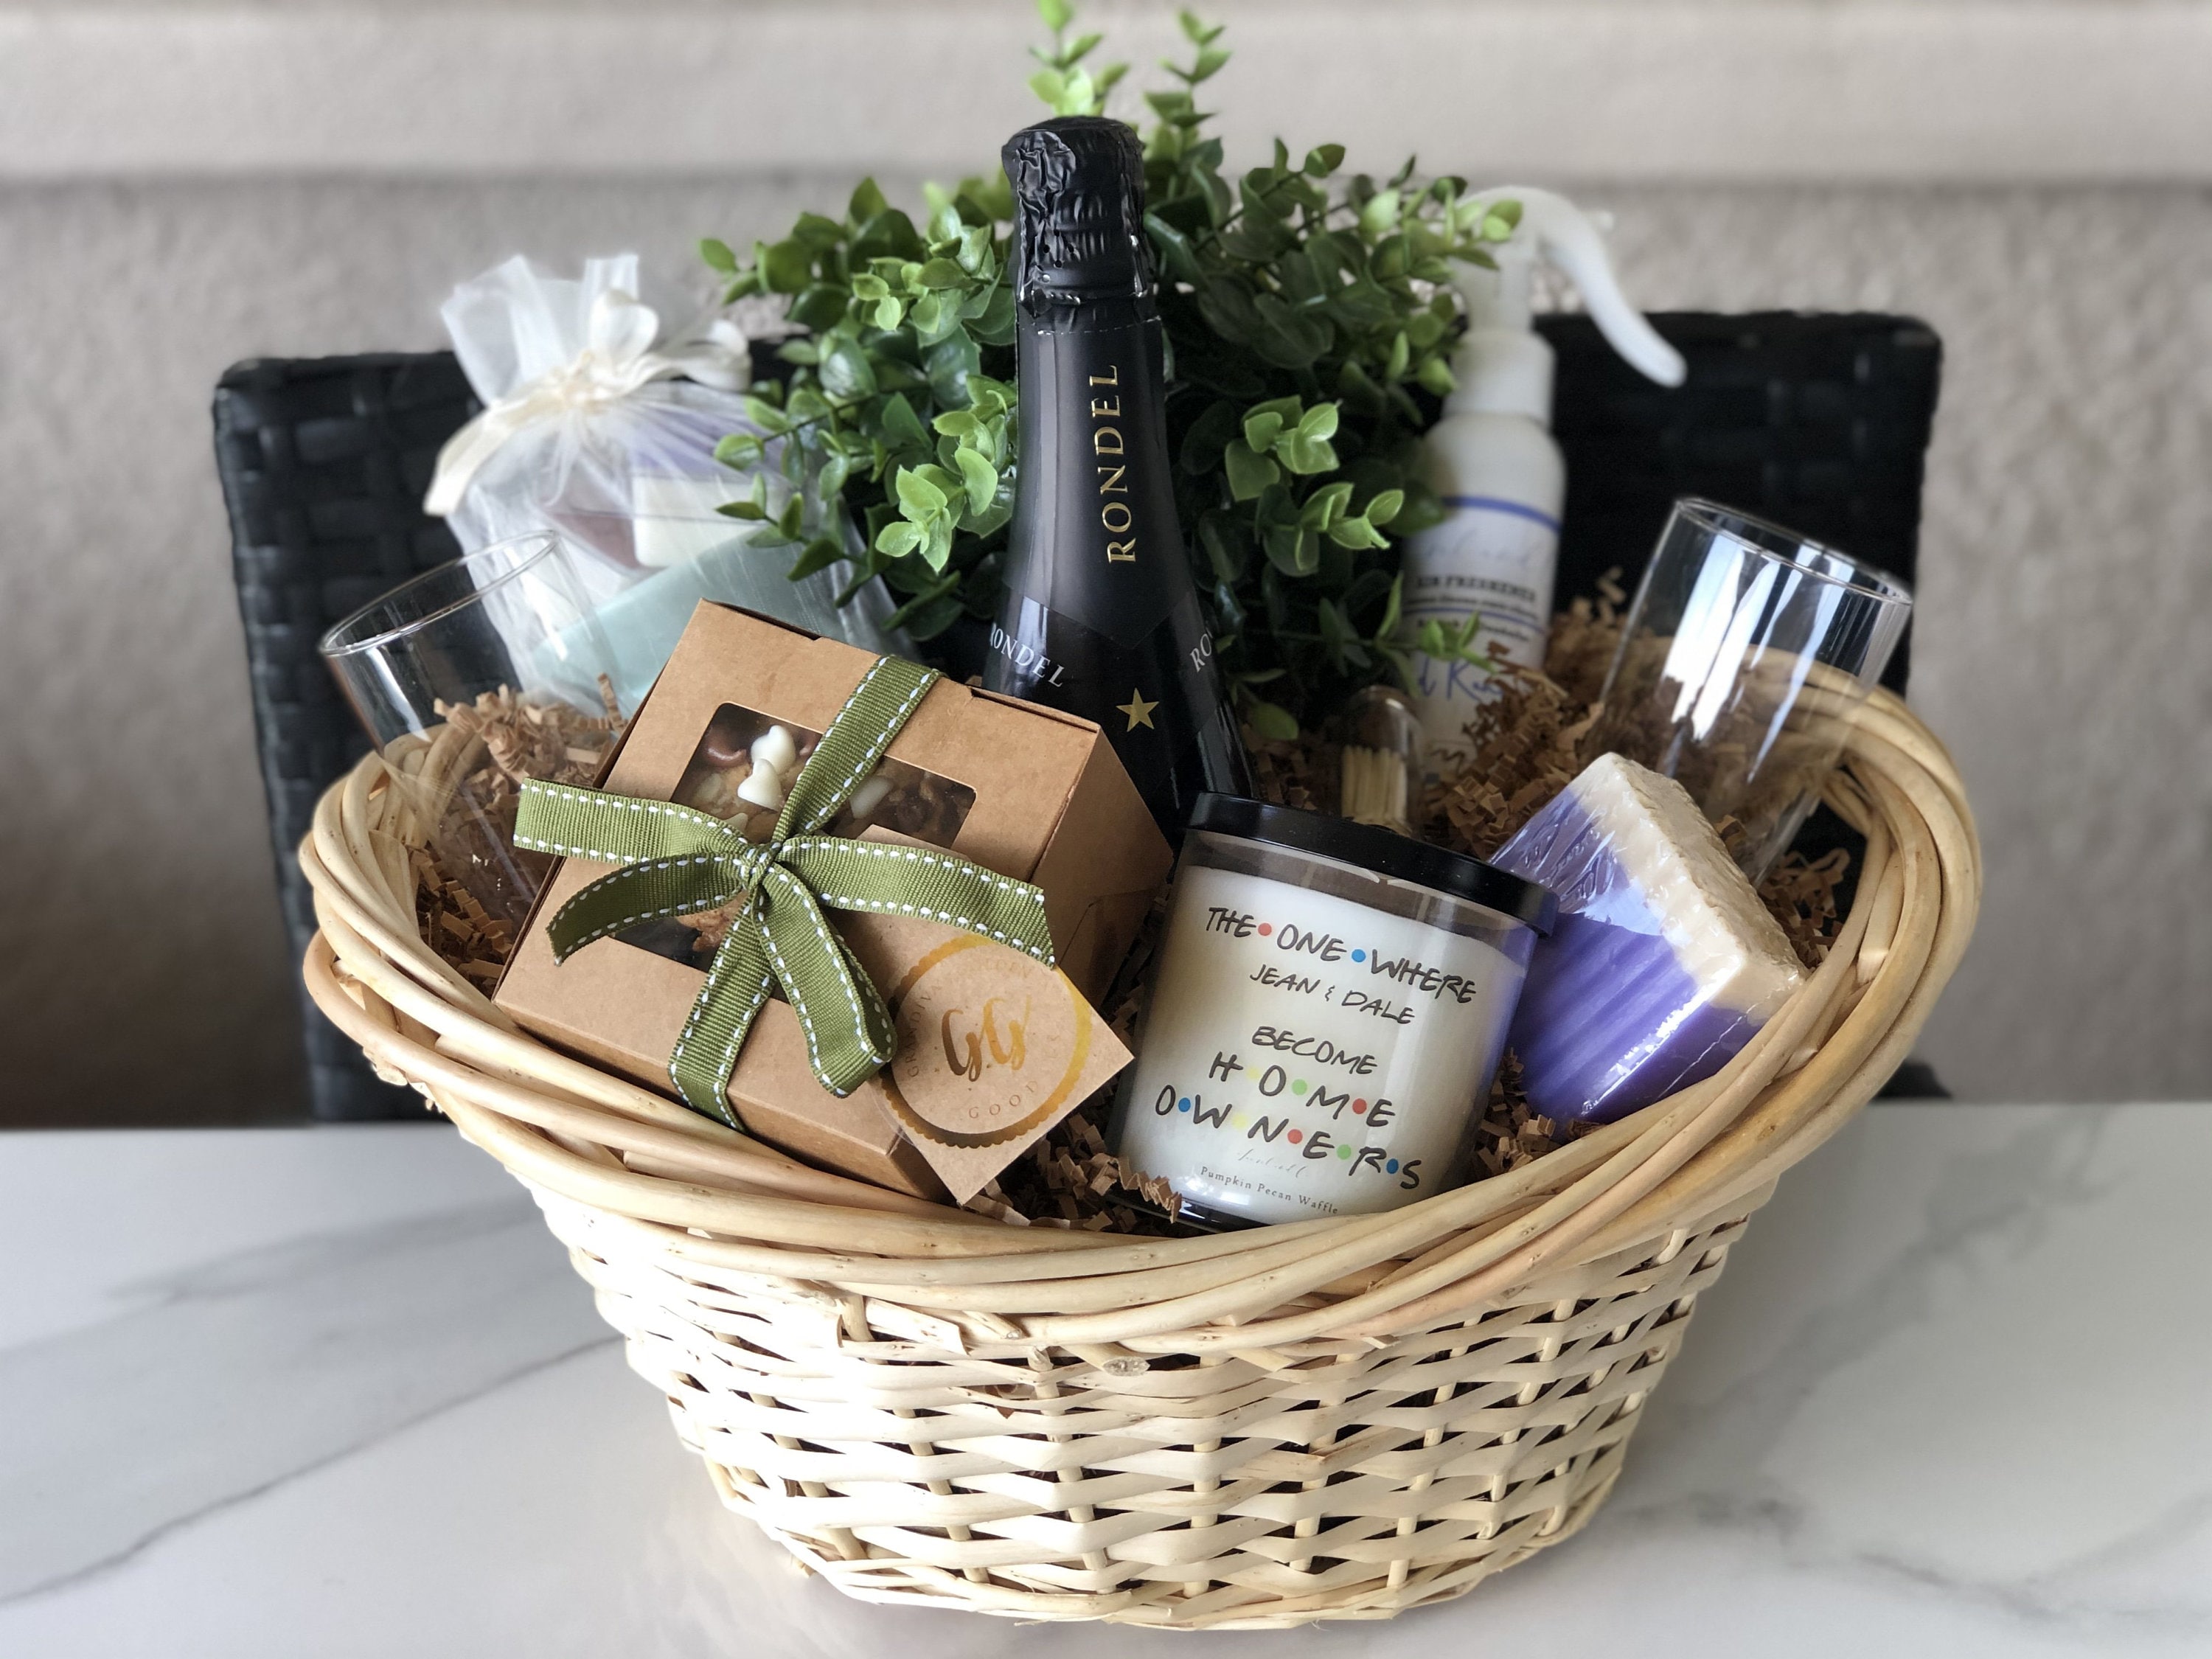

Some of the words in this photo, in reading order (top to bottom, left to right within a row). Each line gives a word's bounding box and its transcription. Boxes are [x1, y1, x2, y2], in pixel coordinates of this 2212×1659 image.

[1088, 364, 1137, 563] RONDEL
[1189, 627, 1214, 672] RO
[1204, 906, 1256, 938] THE
[1276, 924, 1347, 961] ONE
[1371, 948, 1477, 1004] WHERE
[1249, 964, 1321, 995] JEAN
[1340, 990, 1416, 1024] DALE
[1251, 1026, 1379, 1075] BECOME
[1200, 1165, 1253, 1191] Pumpkin
[1257, 1182, 1293, 1201] Pecan
[1298, 1194, 1340, 1215] Waffle
